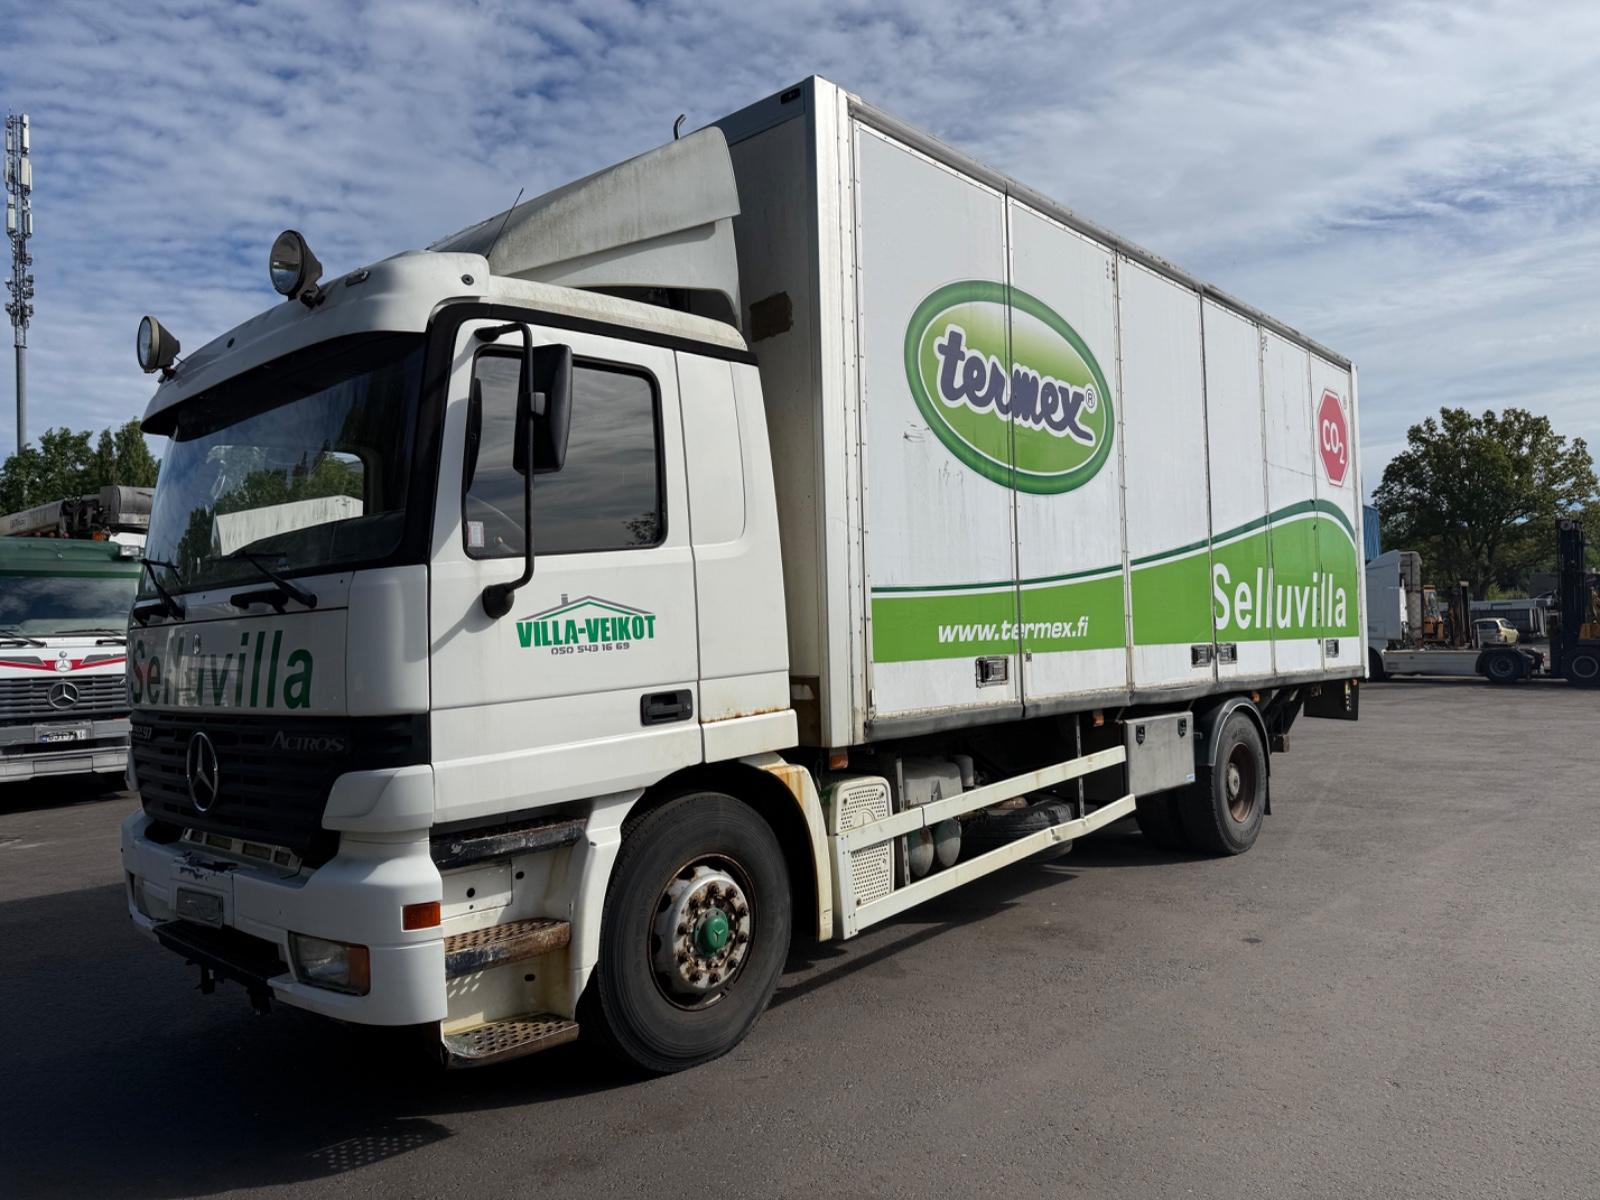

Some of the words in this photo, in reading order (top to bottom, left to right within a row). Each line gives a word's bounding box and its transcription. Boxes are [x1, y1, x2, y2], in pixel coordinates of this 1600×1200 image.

[937, 330, 1093, 441] termex
[1212, 562, 1347, 631] Selluvilla
[516, 614, 656, 648] VILLA-VEIKOT
[938, 615, 1089, 643] www.termex.fi
[551, 646, 574, 656] 050
[577, 644, 599, 653] 543
[602, 642, 613, 651] 16
[616, 641, 630, 650] 69
